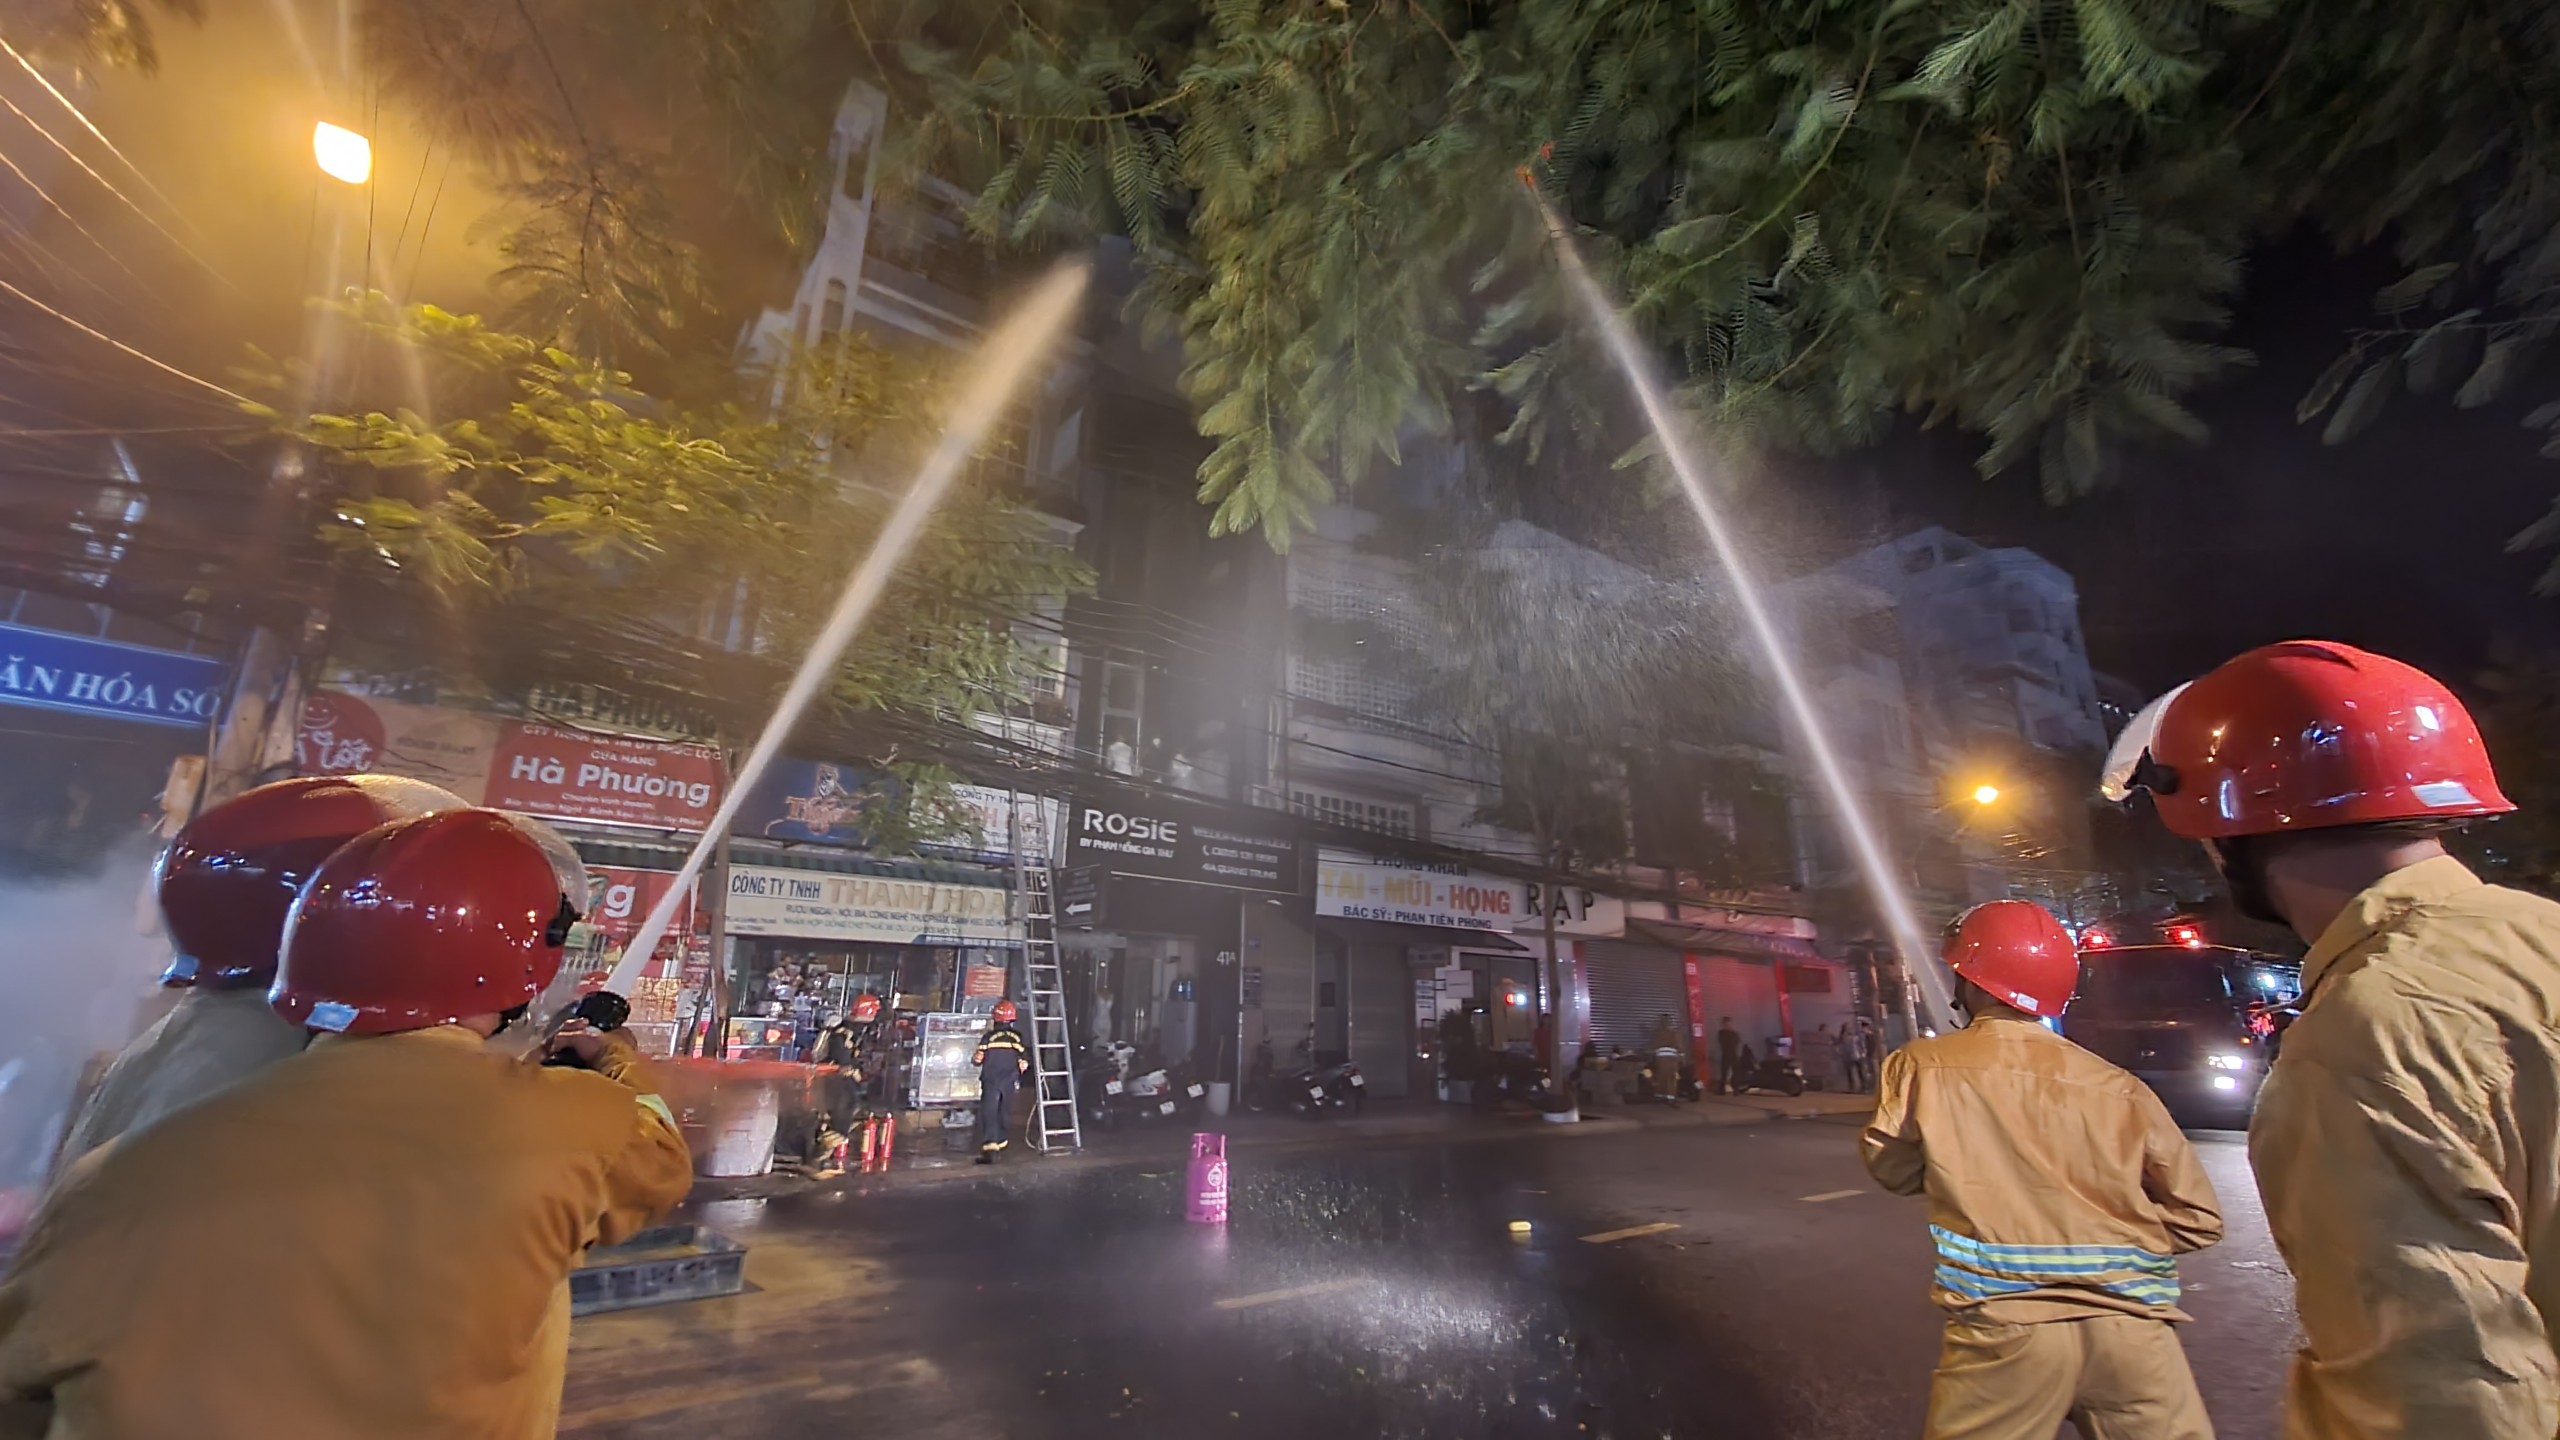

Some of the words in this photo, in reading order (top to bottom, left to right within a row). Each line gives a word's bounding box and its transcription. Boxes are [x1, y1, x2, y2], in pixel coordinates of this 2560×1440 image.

[66, 672, 156, 709] HÓA
[511, 755, 565, 785] Hà
[577, 763, 711, 808] Phương
[732, 869, 766, 895] CÔNG
[770, 878, 785, 896] TY
[789, 879, 821, 899] TNHH
[827, 877, 936, 914] THANH
[1319, 868, 1365, 899] TAI
[1449, 884, 1511, 917] HỌNG
[1343, 904, 1369, 918] BÁC
[1395, 911, 1425, 923] PHAN
[1457, 917, 1492, 929] PHONG
